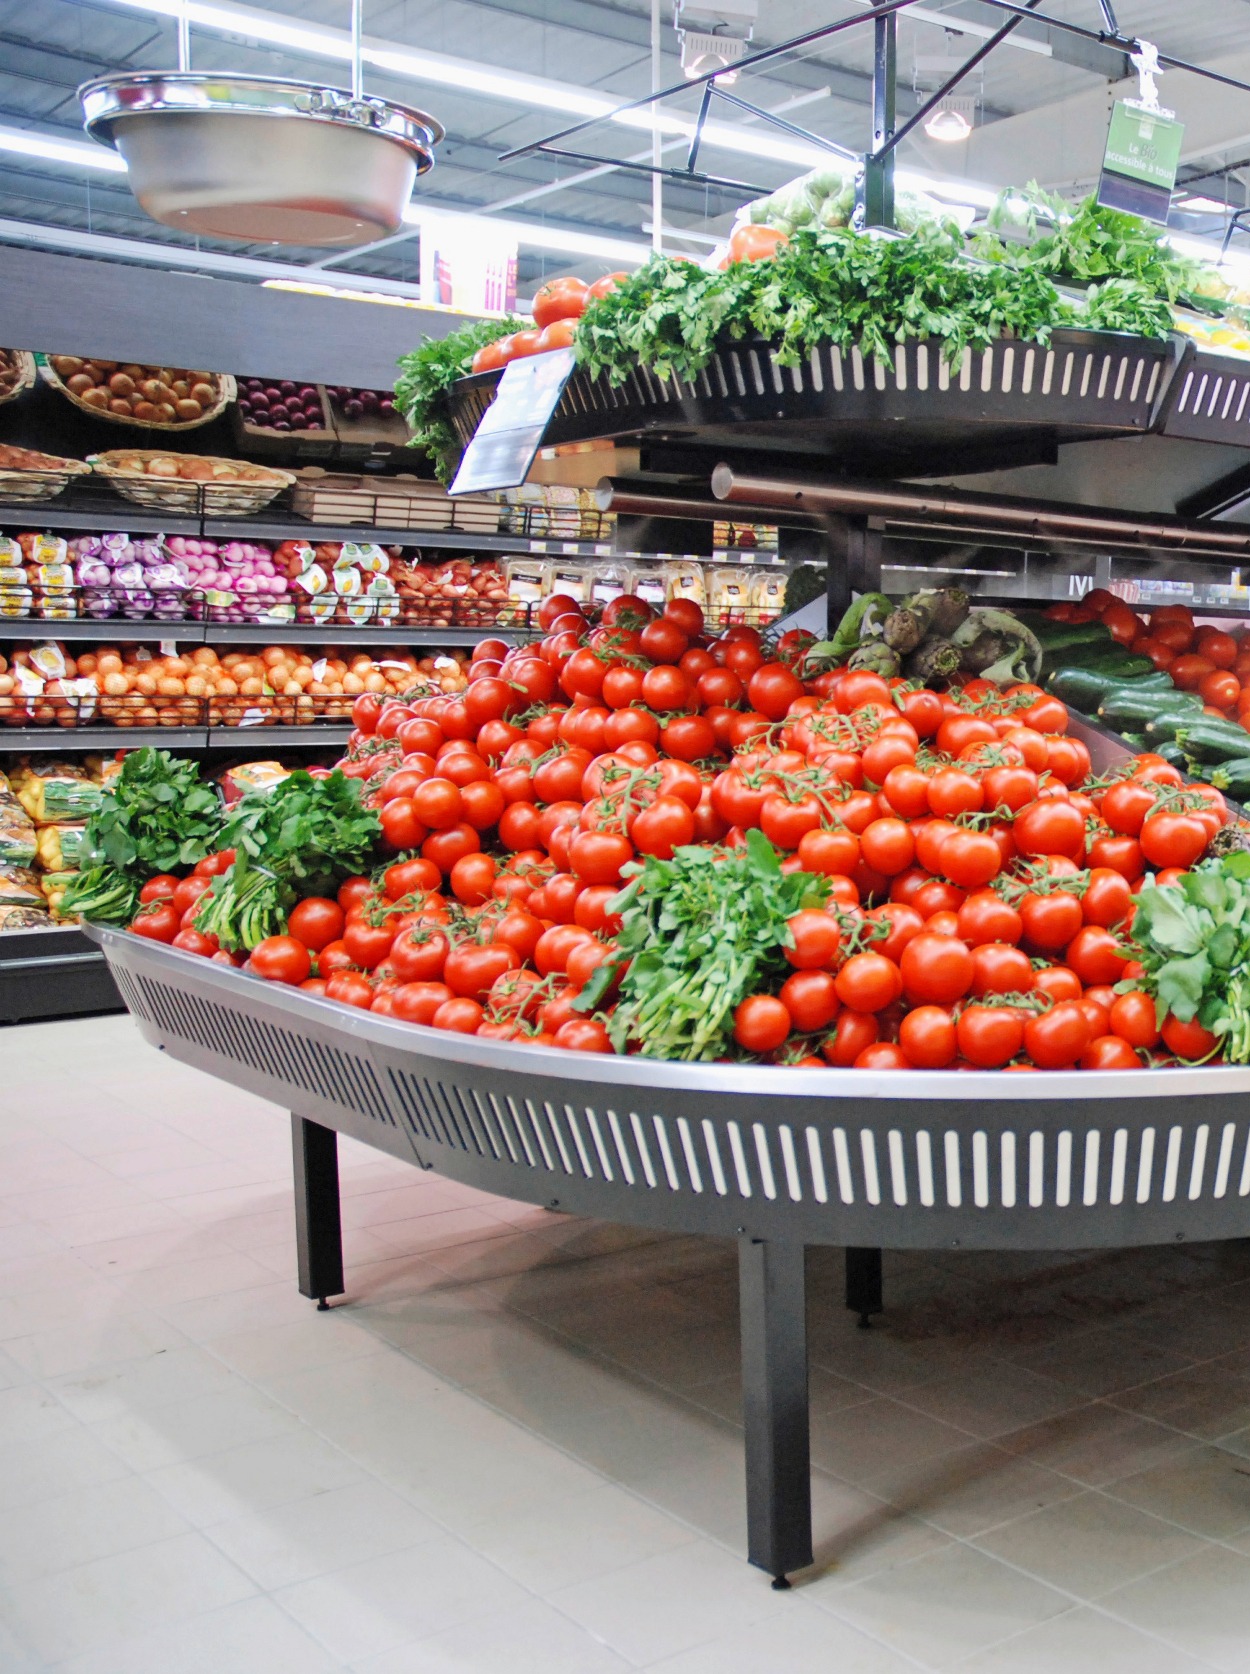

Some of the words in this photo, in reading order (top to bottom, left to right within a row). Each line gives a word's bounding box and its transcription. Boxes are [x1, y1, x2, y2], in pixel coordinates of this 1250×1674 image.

[1129, 143, 1139, 154] Le
[1105, 151, 1146, 171] accessible
[1155, 166, 1174, 179] tous
